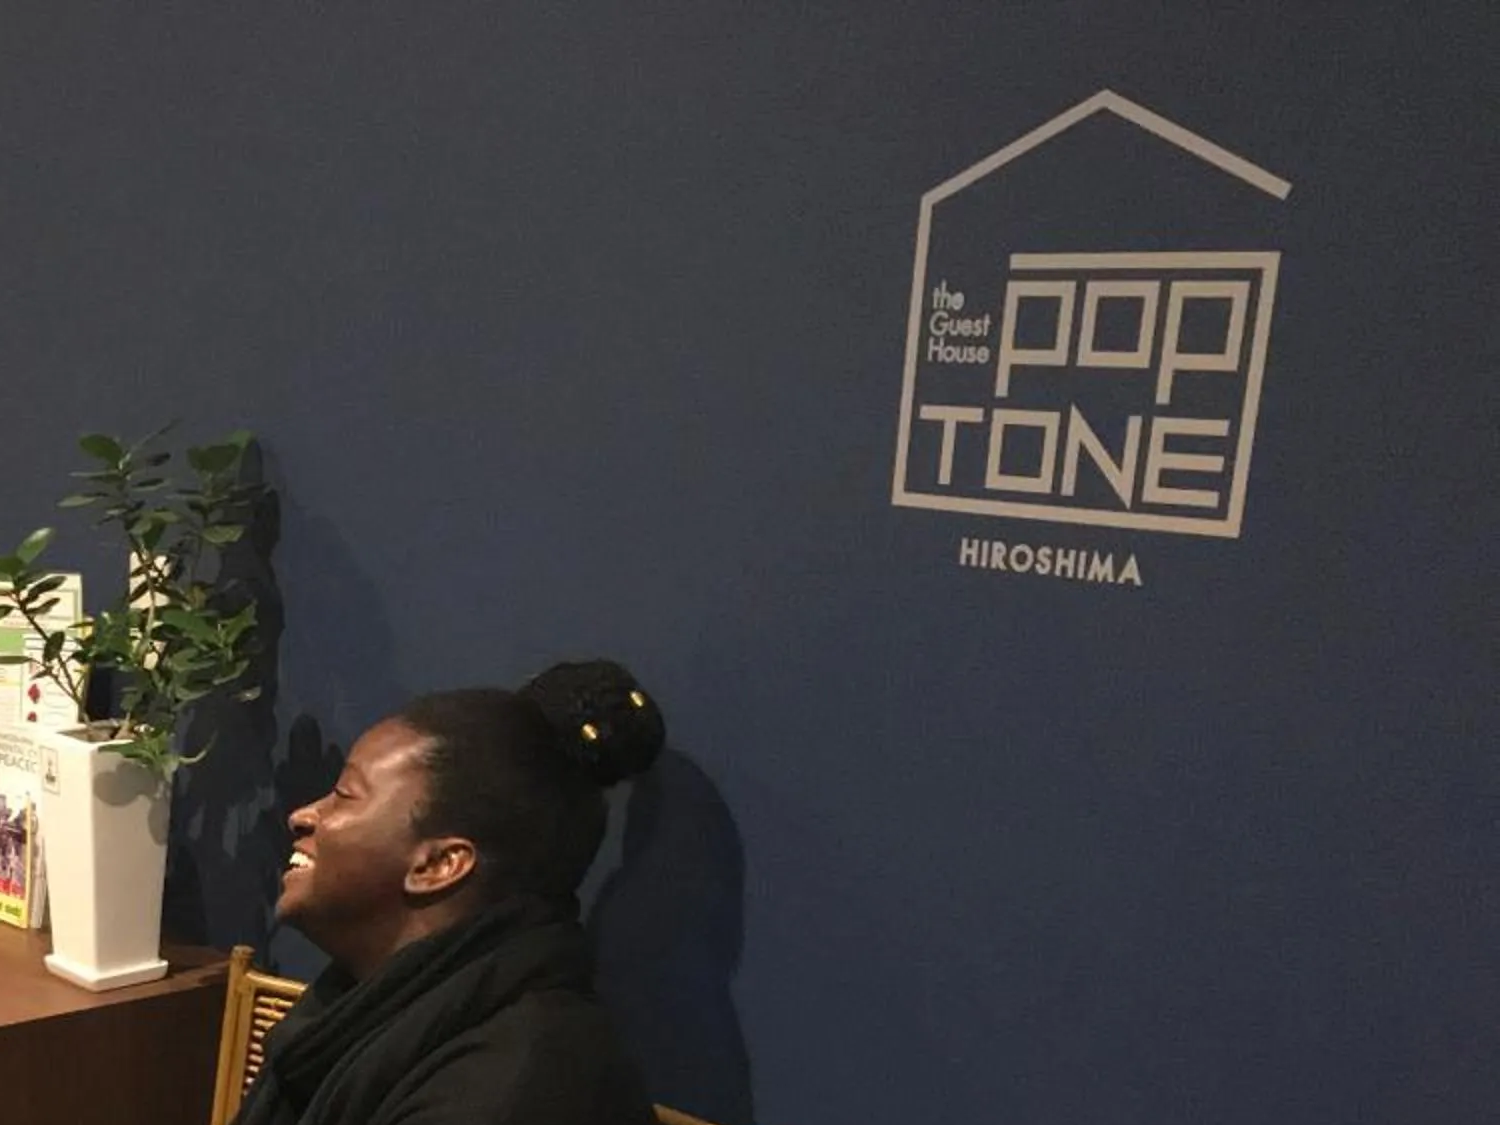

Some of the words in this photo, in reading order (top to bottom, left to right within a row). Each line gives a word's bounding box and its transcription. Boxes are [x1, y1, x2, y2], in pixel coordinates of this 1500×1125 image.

[933, 279, 965, 311] the
[929, 311, 991, 337] Guest
[927, 336, 990, 364] House
[919, 403, 1231, 510] TONE
[958, 537, 1143, 587] HIROSHIMA
